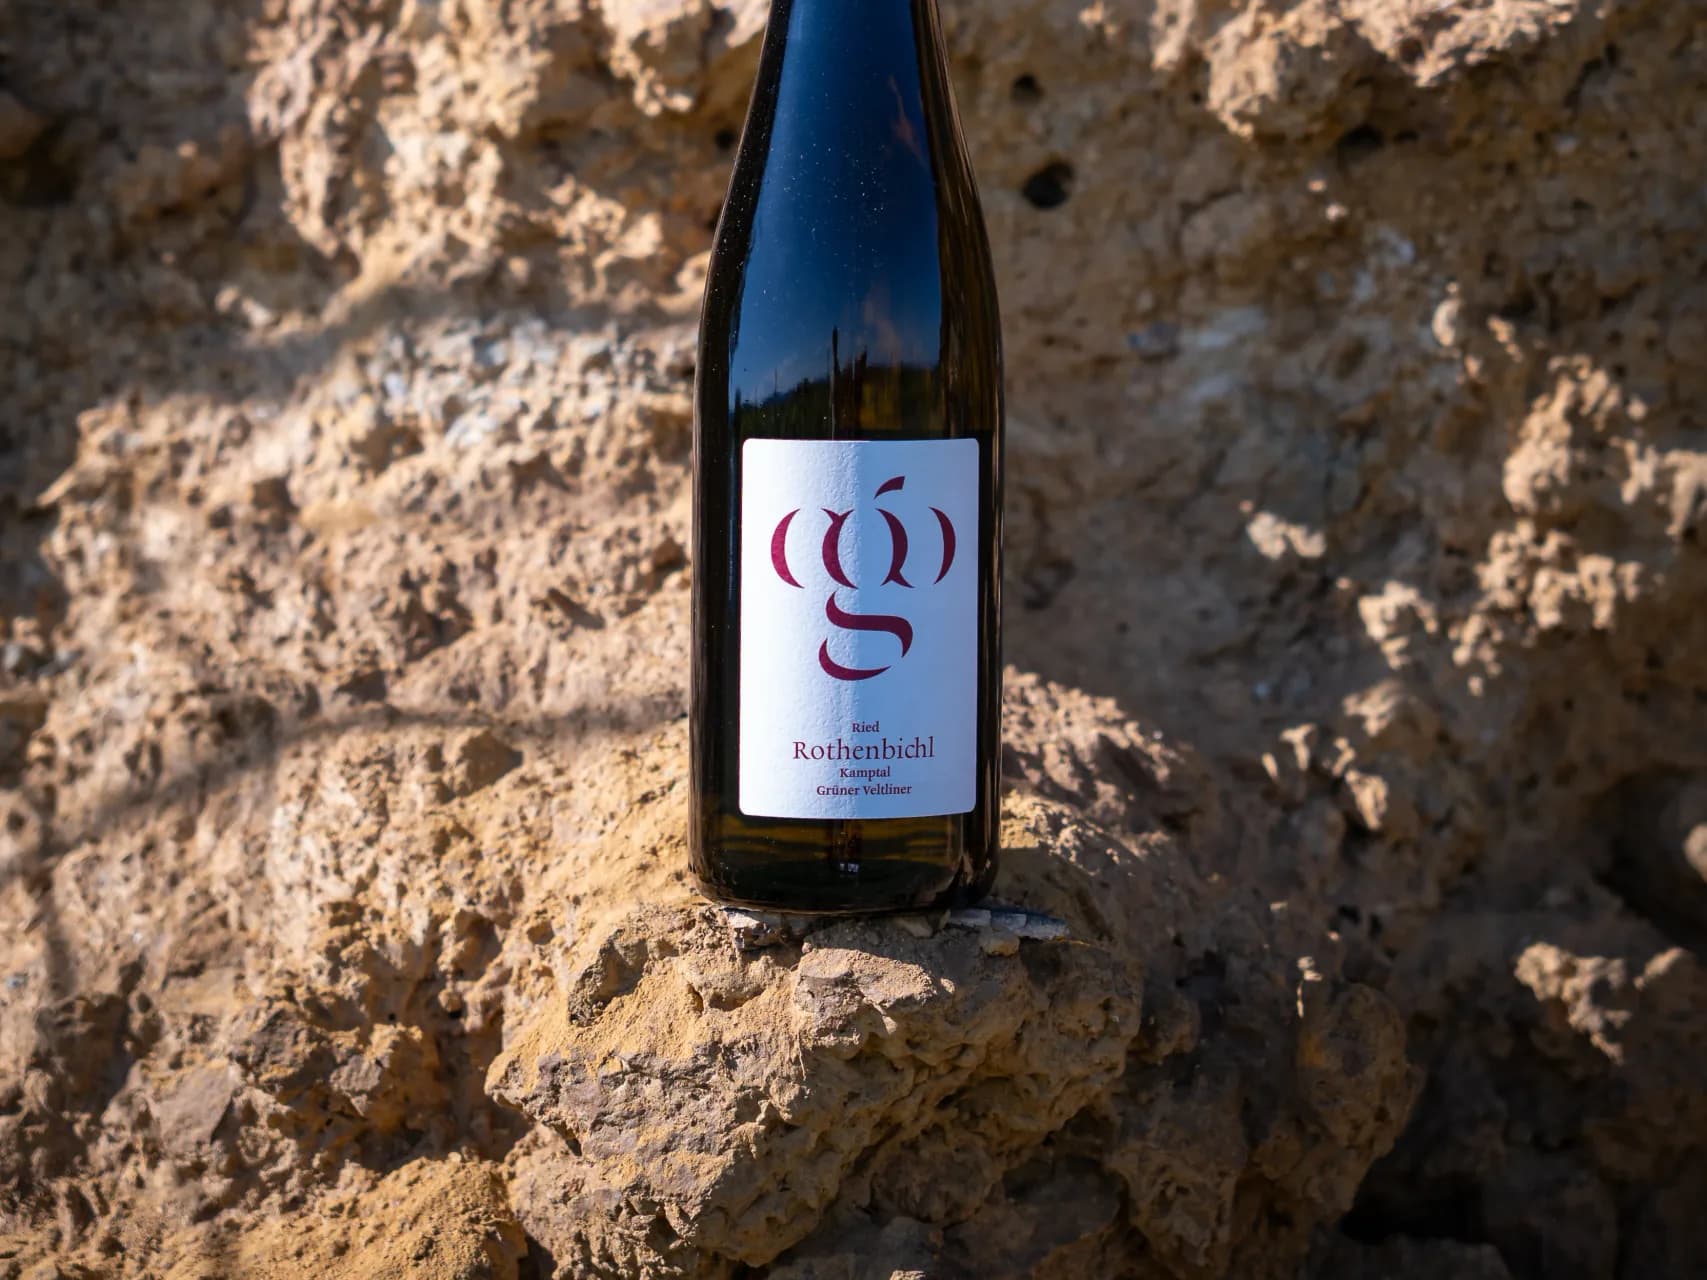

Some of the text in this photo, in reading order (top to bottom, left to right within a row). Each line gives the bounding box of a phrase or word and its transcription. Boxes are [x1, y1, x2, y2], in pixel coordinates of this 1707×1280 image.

[852, 721, 880, 733] Ried
[792, 736, 935, 760] Rothenbichl
[839, 766, 891, 782] Kamptal
[816, 783, 912, 796] Grüner Veltliner
